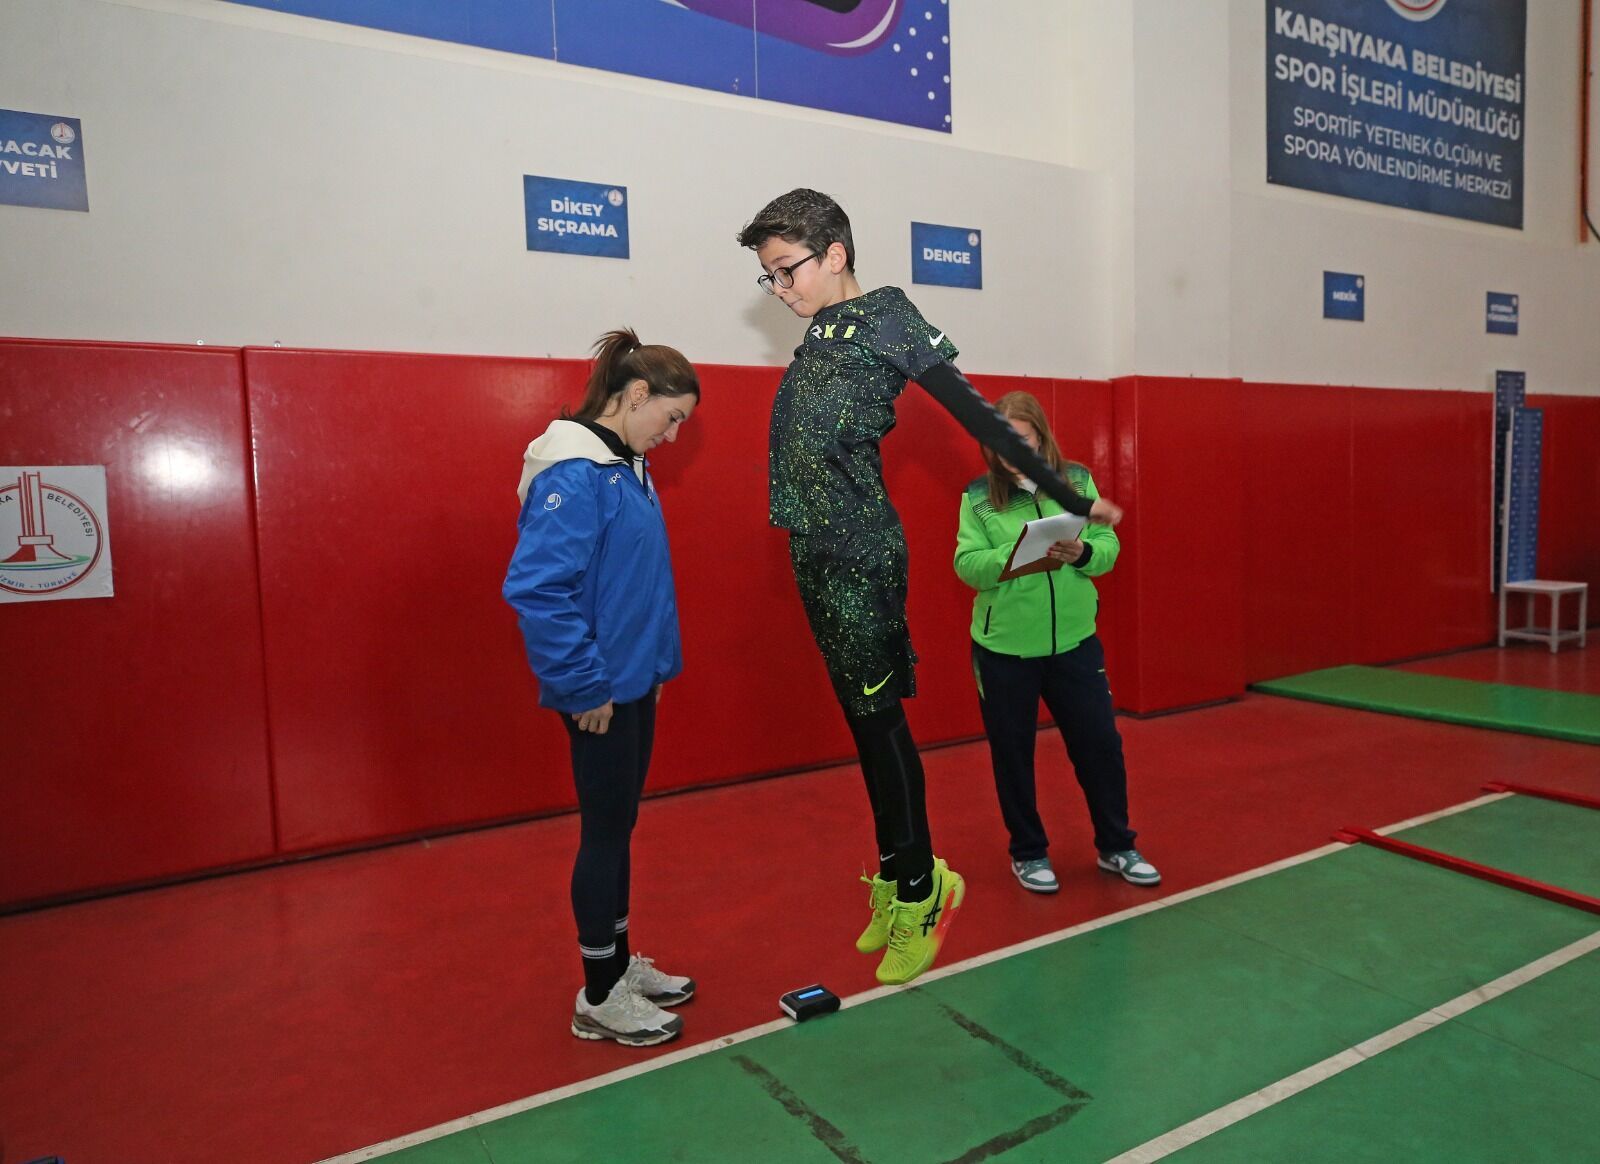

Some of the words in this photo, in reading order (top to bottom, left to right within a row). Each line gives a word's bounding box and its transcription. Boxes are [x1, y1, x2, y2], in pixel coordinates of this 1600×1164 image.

[1274, 7, 1408, 71] KARŞIYAKA
[1412, 50, 1521, 104] BELEDİYESİ
[1274, 53, 1336, 93] SPOR
[1341, 64, 1402, 110] İŞLERİ
[1407, 89, 1520, 141] MÜDÜRLÜĞÜ
[0, 140, 72, 160] ACAK
[1293, 106, 1362, 139] SPORTİF
[1365, 123, 1431, 156] YETENEK
[1435, 137, 1483, 168] ÖLÇÜM
[1484, 154, 1503, 173] VE
[0, 160, 58, 179] VETİ
[1284, 134, 1342, 165] SPORA
[1344, 147, 1452, 189] YÖNLENDİRME
[1454, 172, 1512, 200] MERKEZİ
[550, 196, 604, 217] DİKEY
[537, 217, 619, 238] SIÇRAMA
[923, 247, 971, 265] DENGE
